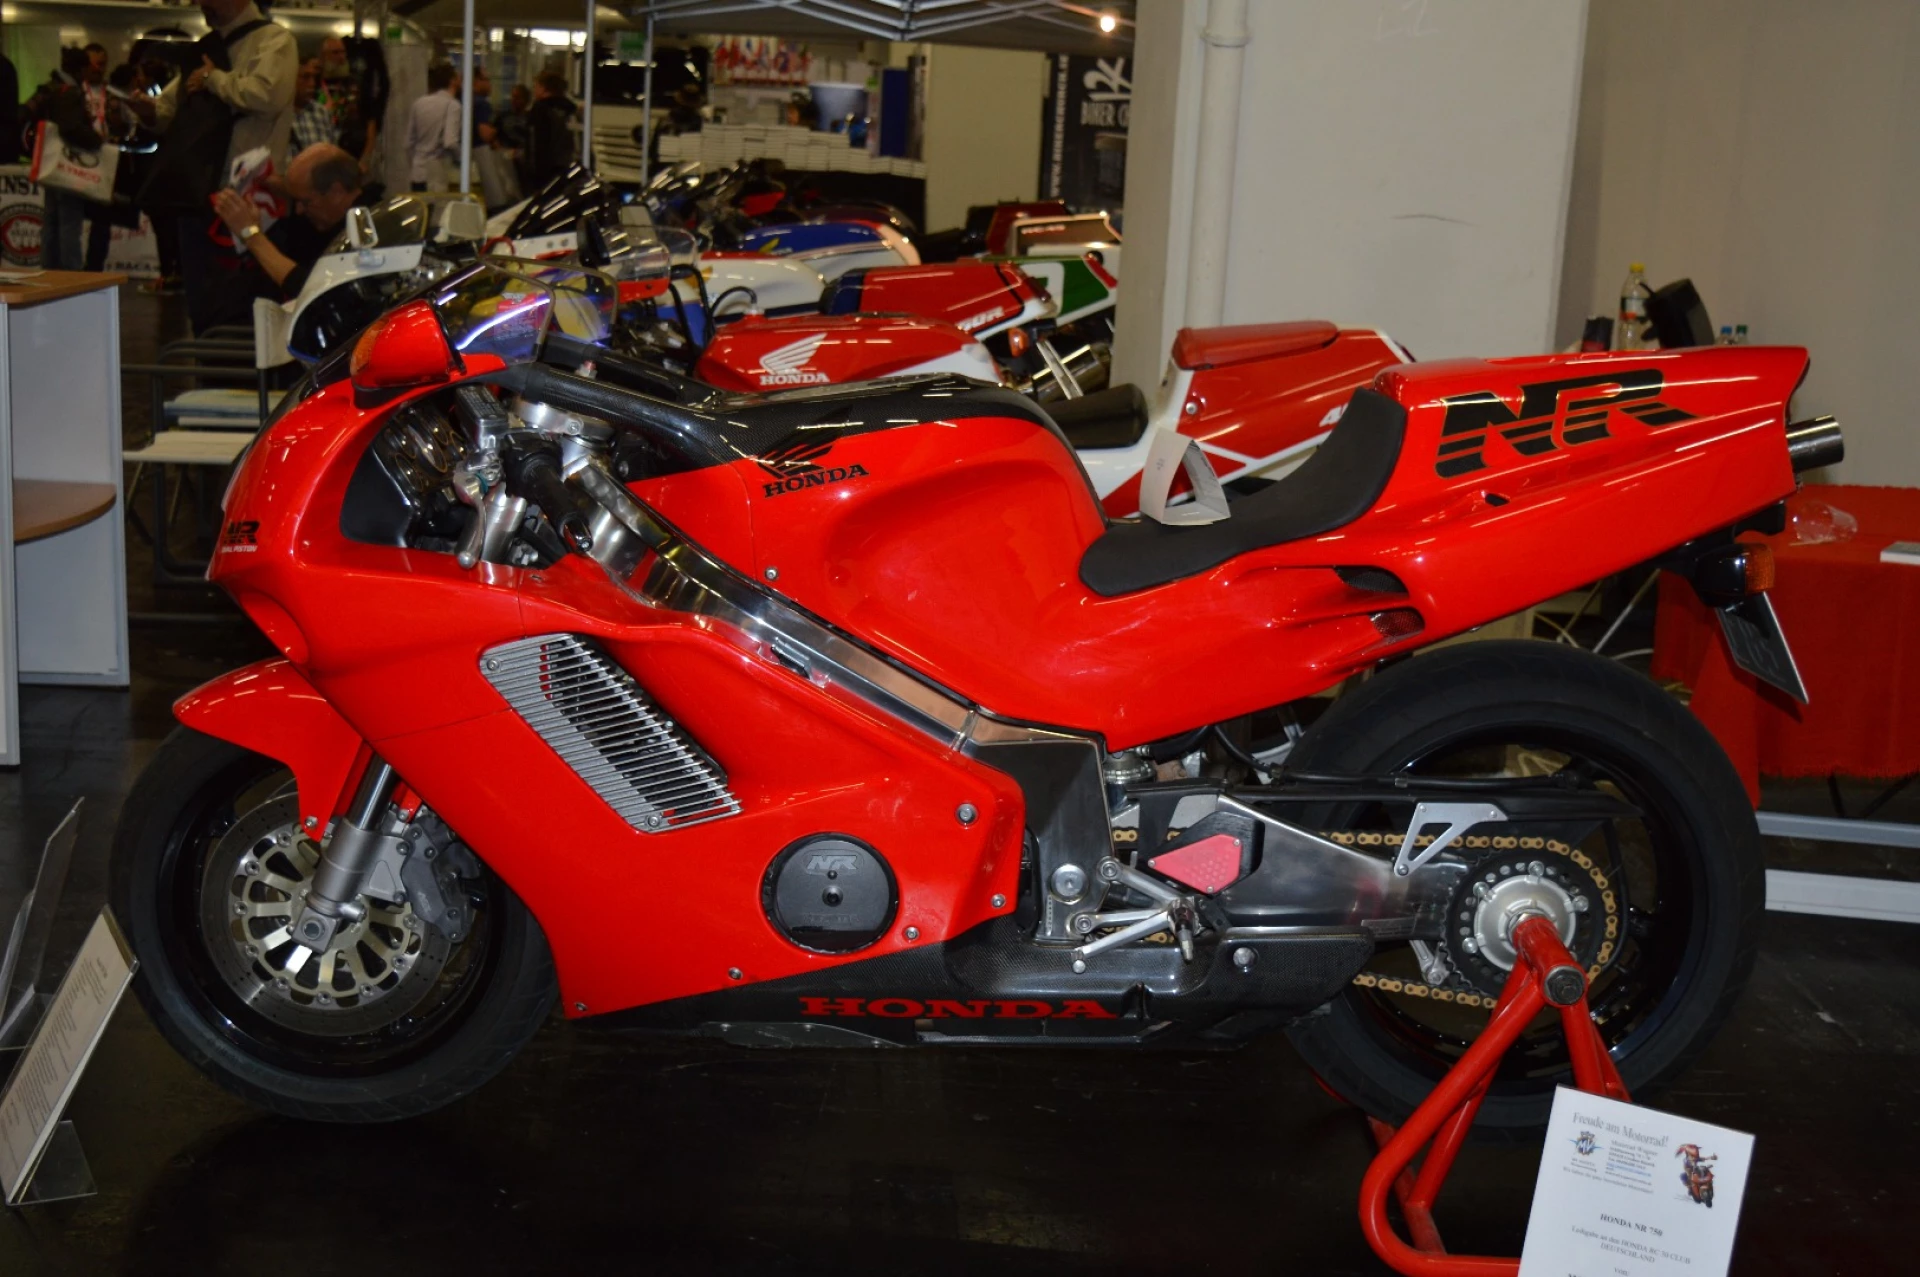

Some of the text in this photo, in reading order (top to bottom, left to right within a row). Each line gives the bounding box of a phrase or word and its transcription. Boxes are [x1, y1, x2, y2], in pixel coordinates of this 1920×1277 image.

[759, 371, 830, 386] HONDA
[1433, 367, 1702, 479] NR
[763, 462, 870, 498] HONDA
[806, 854, 859, 871] NR
[799, 997, 1119, 1020] HONDA
[1572, 1111, 1669, 1148] Freude am Motorrad!
[1600, 1213, 1663, 1237] HONDA NR 750
[1600, 1242, 1655, 1263] DEUTSCHLAND
[1621, 1239, 1648, 1253] HONDA
[1669, 1253, 1691, 1264] CLUB
